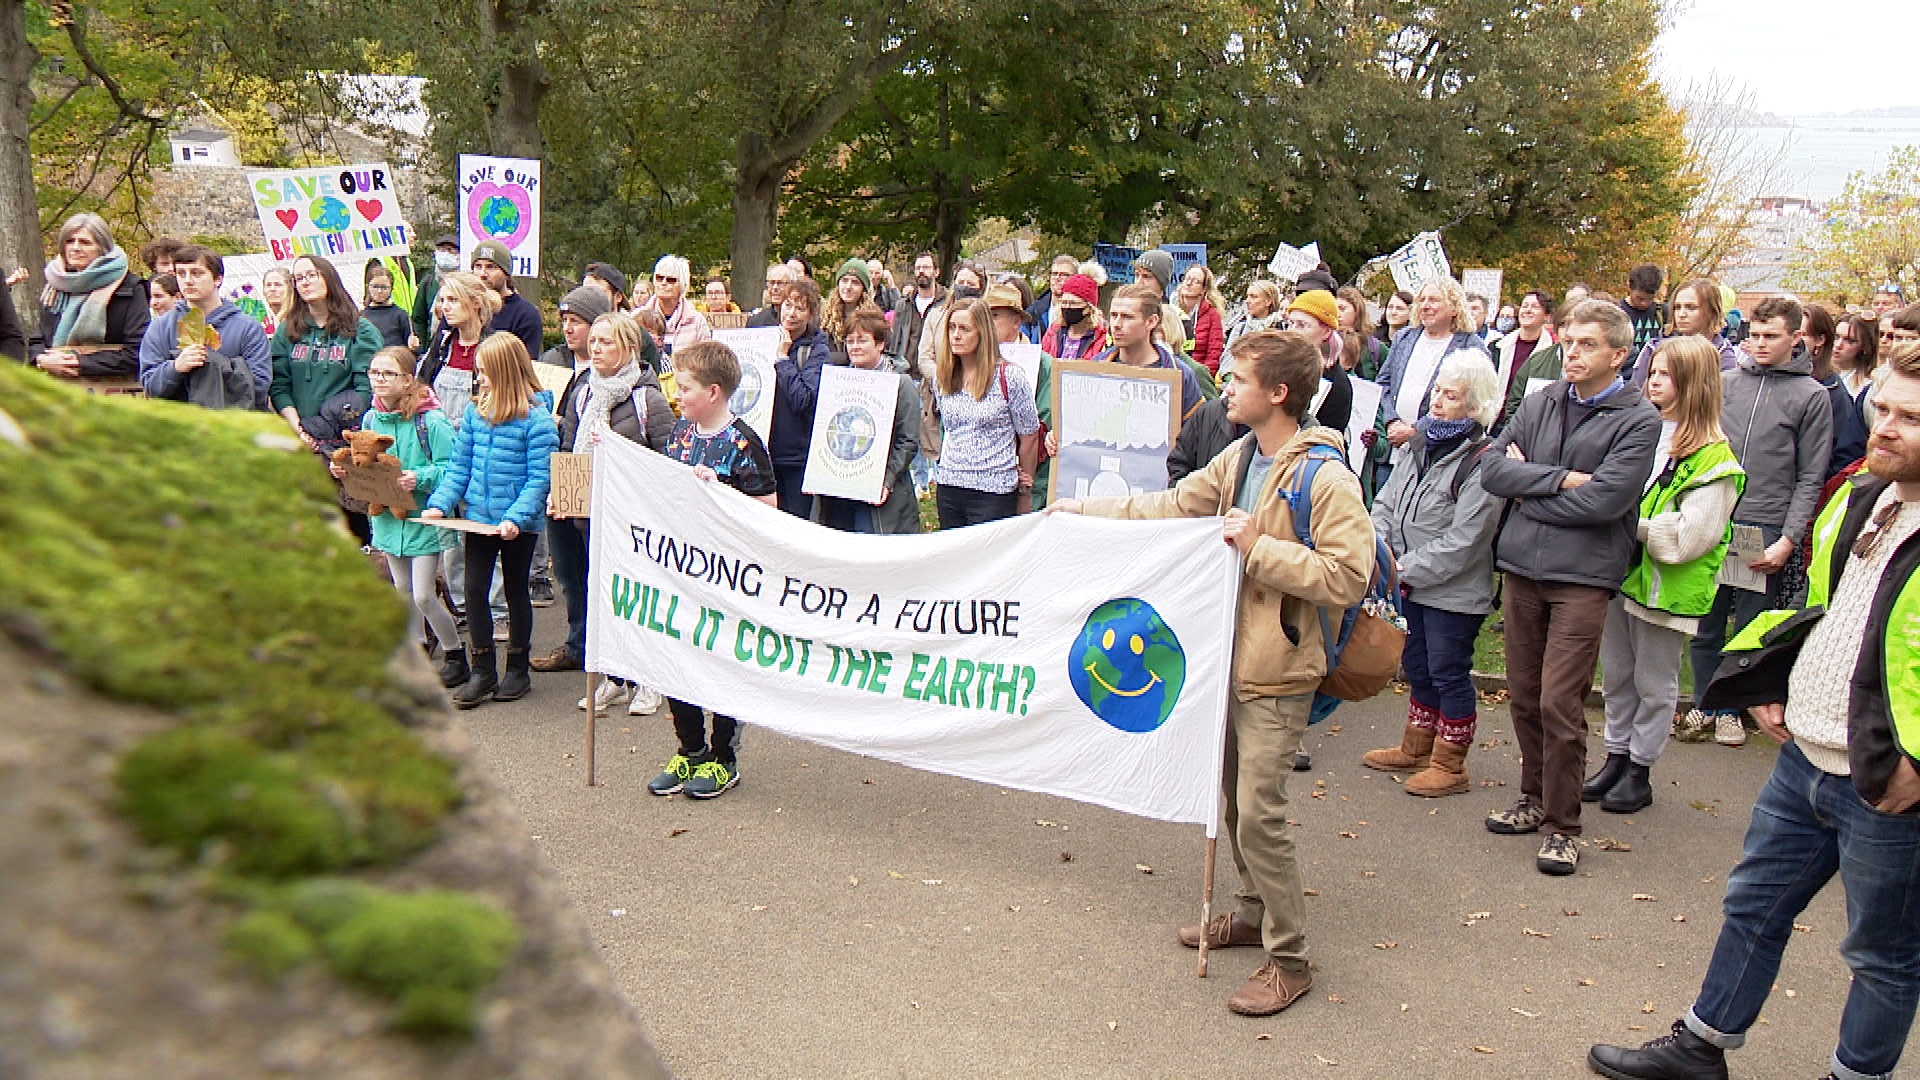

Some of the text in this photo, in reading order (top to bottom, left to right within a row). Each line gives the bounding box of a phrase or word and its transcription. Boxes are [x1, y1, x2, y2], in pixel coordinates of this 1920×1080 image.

[255, 169, 387, 208] SAVE OUR
[461, 166, 538, 194] LOVE OUR
[270, 225, 407, 261] BEAUTIFUL PLANET
[1171, 251, 1198, 261] THINK
[1119, 381, 1168, 404] SINK
[558, 455, 593, 472] SMALL
[558, 471, 591, 487] ISLAN
[558, 485, 585, 513] BIG
[630, 523, 1020, 638] FUNDING FOR A FUTURE
[611, 573, 1036, 716] WILL IT COST THE EARTH?
